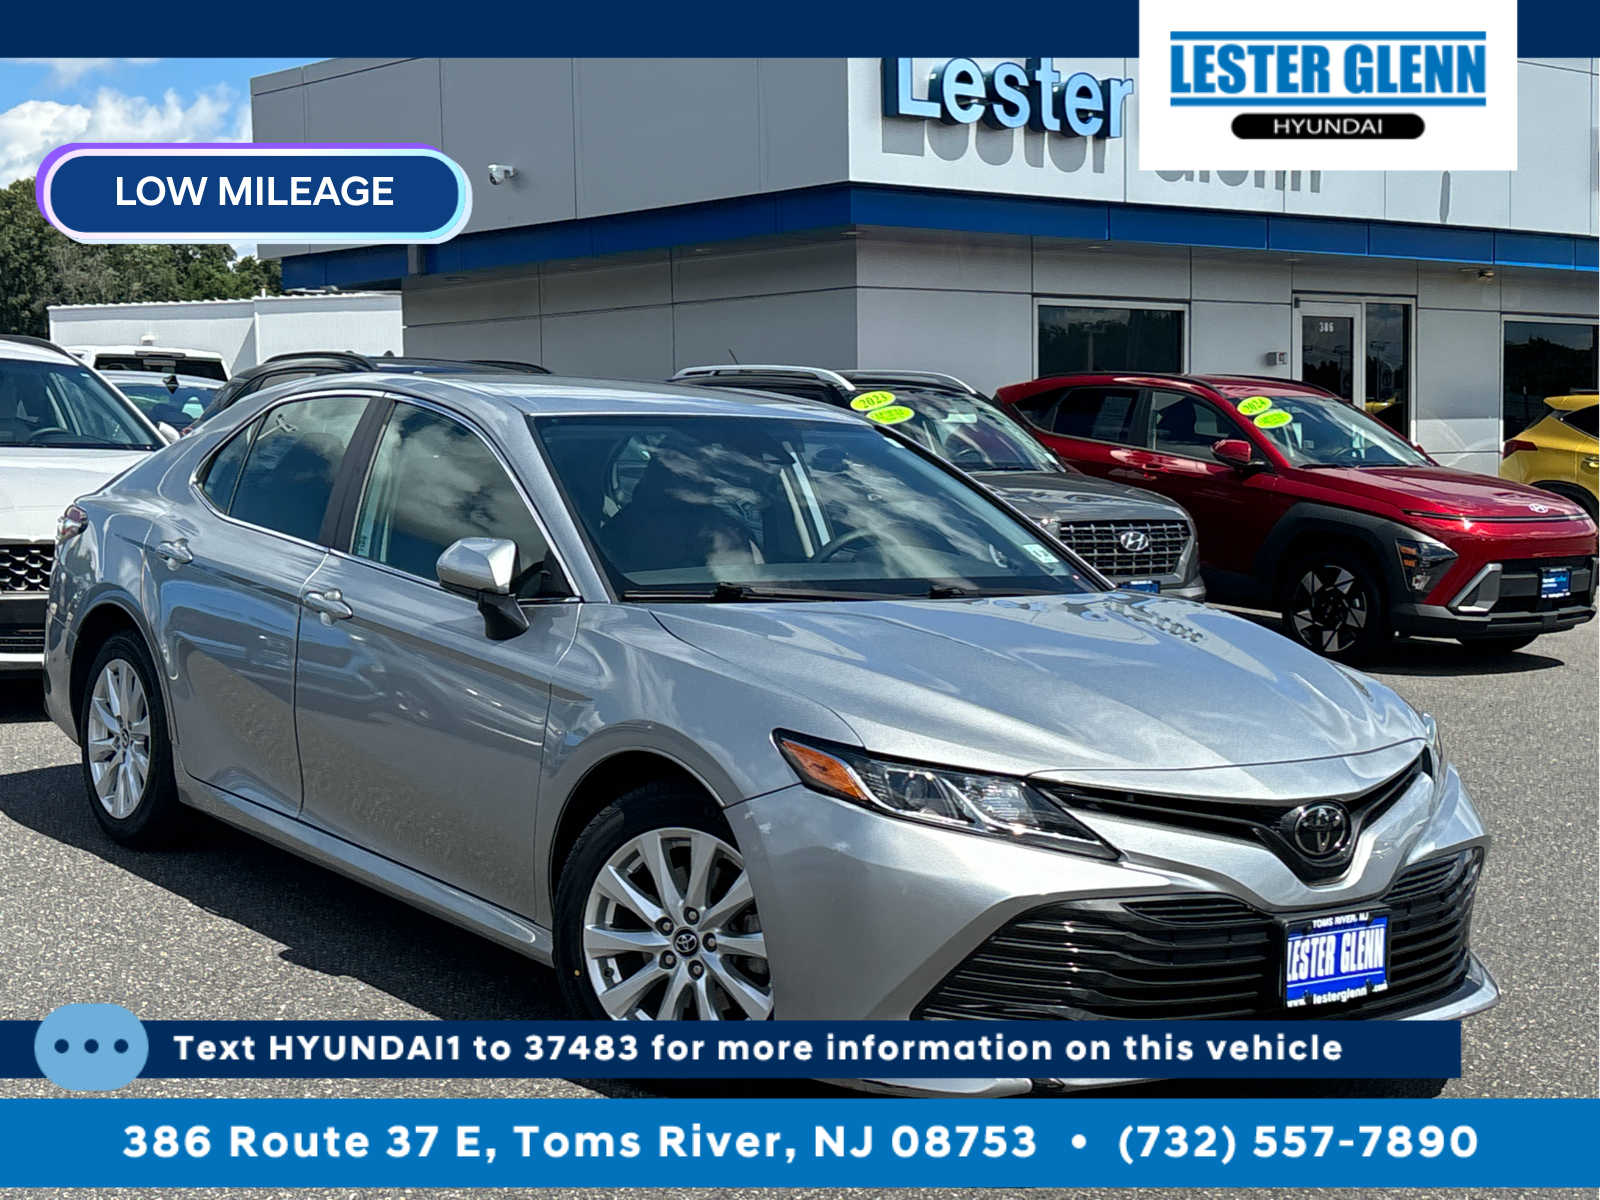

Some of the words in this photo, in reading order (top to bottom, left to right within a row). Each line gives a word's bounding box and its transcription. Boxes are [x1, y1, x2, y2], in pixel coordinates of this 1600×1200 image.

[894, 57, 1134, 138] Lester
[1286, 935, 1336, 983] LESTER
[1341, 927, 1385, 974] GLENN
